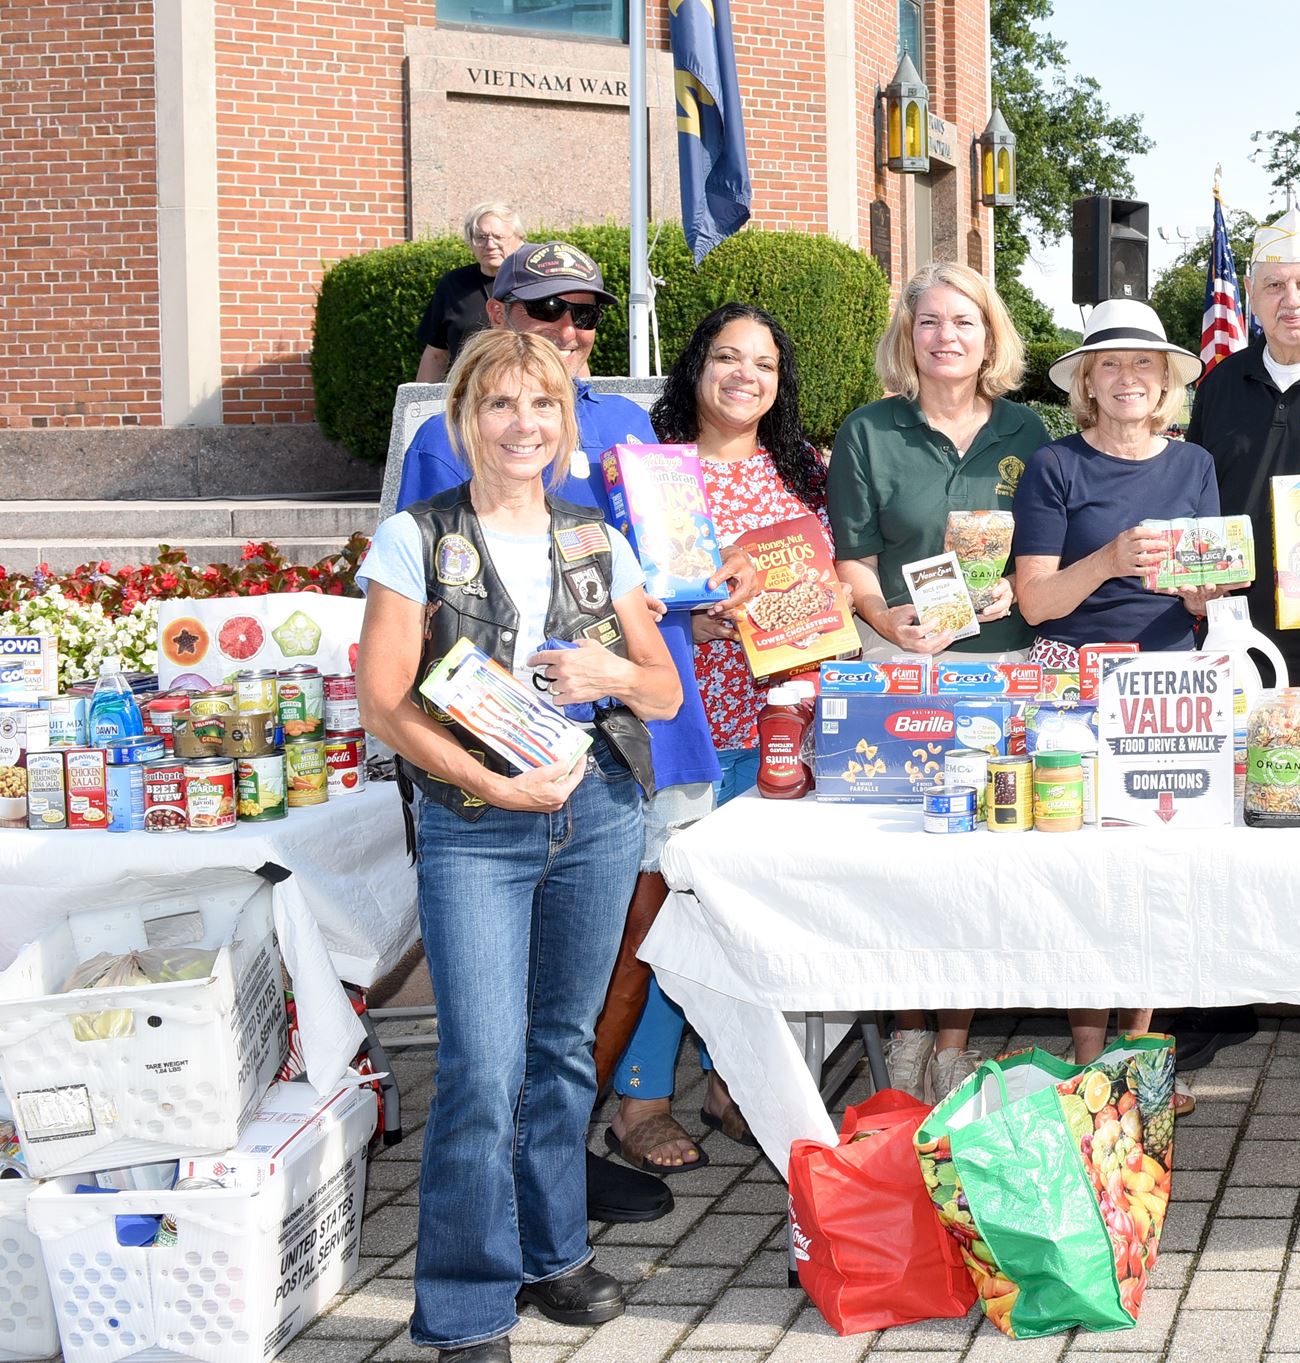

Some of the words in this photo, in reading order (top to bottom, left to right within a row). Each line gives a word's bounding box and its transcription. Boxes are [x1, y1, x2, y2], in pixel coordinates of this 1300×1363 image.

[467, 67, 572, 93] VIETNAM
[579, 77, 628, 97] WAR
[670, 471, 697, 486] Bran
[757, 540, 785, 552] Honey
[786, 534, 804, 545] Nut
[750, 543, 816, 572] heerios
[768, 575, 796, 588] HONEY
[771, 571, 791, 581] REAL
[756, 632, 786, 647] LOWER
[786, 616, 839, 639] CHOLESTEROL
[824, 670, 872, 682] Crest
[896, 669, 919, 678] CAVITY
[942, 672, 991, 683] Crest
[1017, 669, 1039, 678] CAVITY
[1116, 669, 1218, 696] VETERANS
[1119, 696, 1213, 735] VALOR
[66, 719, 84, 728] MIX
[95, 725, 118, 736] DAWN
[894, 716, 953, 733] Barilla
[1010, 726, 1026, 734] Lipto
[1119, 738, 1145, 753] FOOD
[1147, 737, 1177, 752] DRIVE
[1178, 739, 1186, 751] &
[1187, 737, 1216, 751] WALK
[70, 768, 100, 777] CHICKEN
[143, 771, 184, 782] Southgate
[72, 777, 100, 786] SALAD
[145, 784, 178, 794] BEEF
[1133, 773, 1204, 790] DONATIONS
[152, 793, 182, 802] STEW
[192, 799, 215, 807] Ravioli
[236, 1019, 257, 1061] UNITED
[256, 978, 277, 1025] STATES
[238, 1044, 261, 1091] POSTAL
[260, 998, 282, 1047] SERVICE
[145, 1062, 162, 1070] TARE
[163, 1060, 189, 1068] WEIGHT
[282, 1203, 305, 1229] WARNING
[308, 1191, 318, 1207] NOT
[318, 1183, 328, 1196] FOR
[280, 1228, 318, 1276] UNITED
[319, 1192, 354, 1239] STATES
[274, 1255, 315, 1307] POSTAL
[317, 1212, 357, 1264] SERVICE
